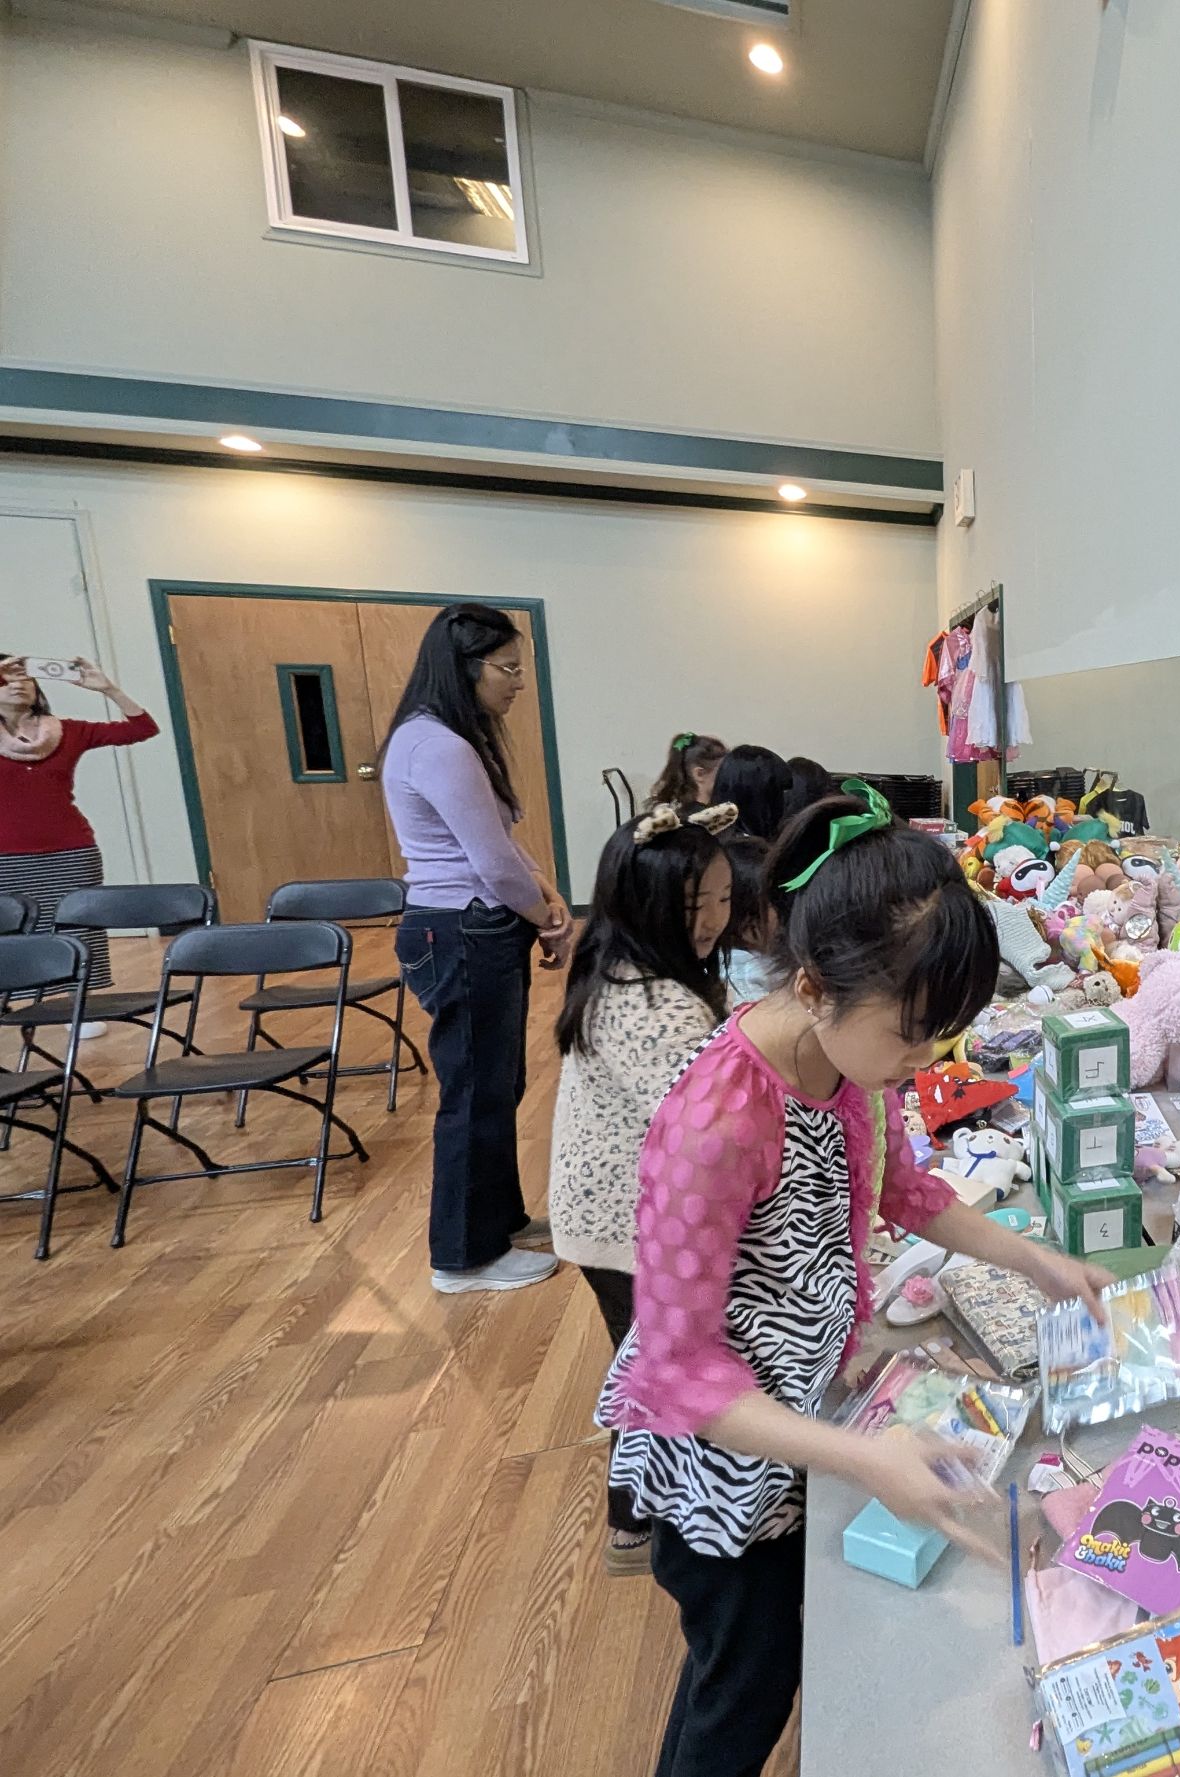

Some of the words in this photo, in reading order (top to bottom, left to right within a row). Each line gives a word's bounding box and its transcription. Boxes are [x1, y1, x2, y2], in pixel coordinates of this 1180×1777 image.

[1074, 1545, 1088, 1560] &
[1085, 1549, 1126, 1572] bakit
[1080, 1534, 1131, 1559] makit
